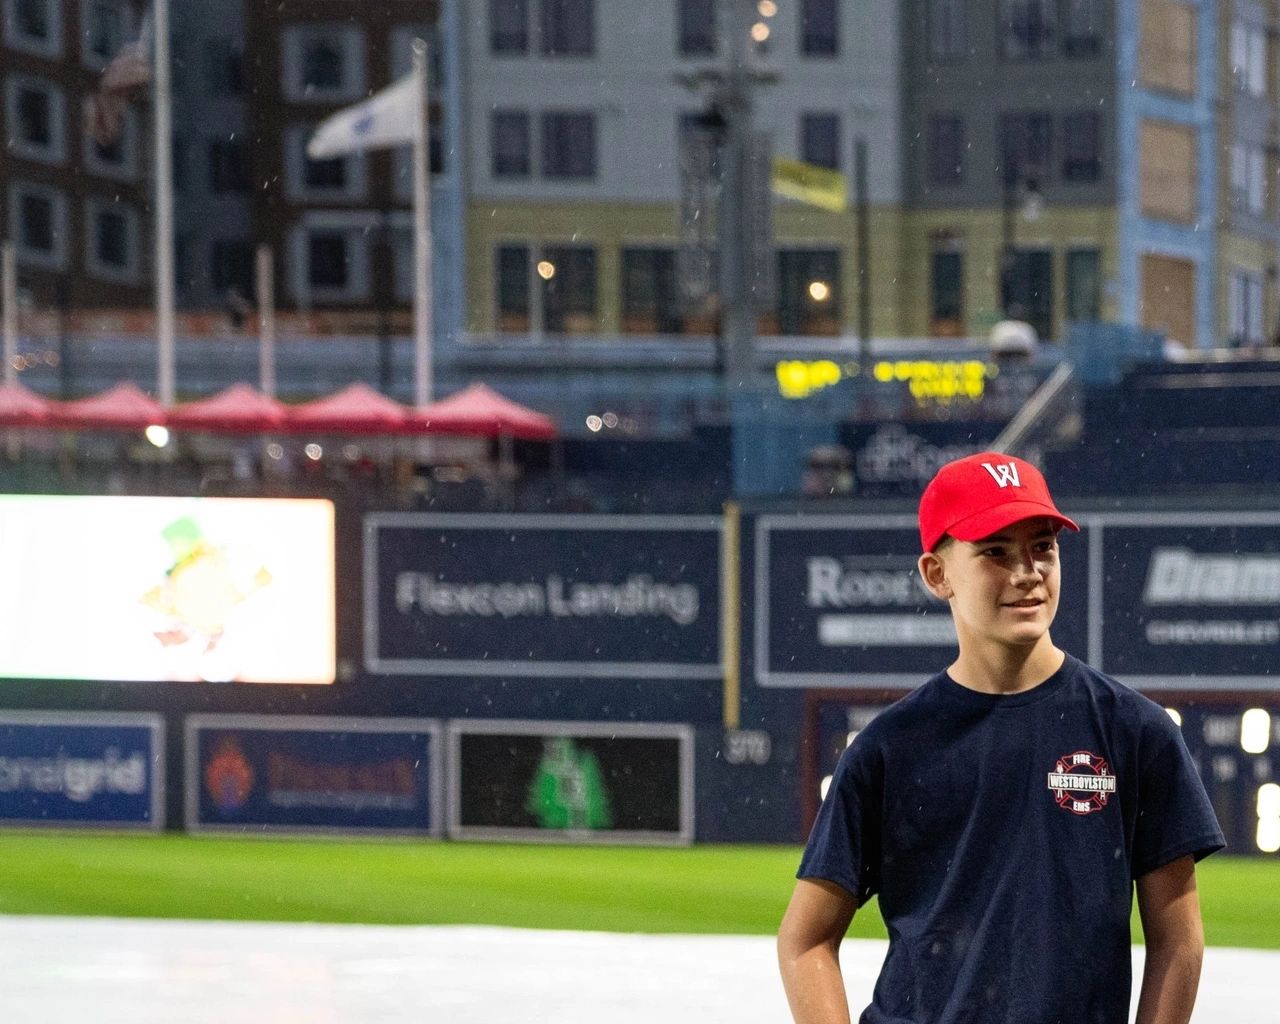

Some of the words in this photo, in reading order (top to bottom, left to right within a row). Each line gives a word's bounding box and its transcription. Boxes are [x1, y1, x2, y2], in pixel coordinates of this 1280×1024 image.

[396, 571, 546, 617] Flexcon
[548, 572, 699, 625] Landing
[1073, 754, 1091, 765] FIRE
[1073, 801, 1091, 812] EMS
